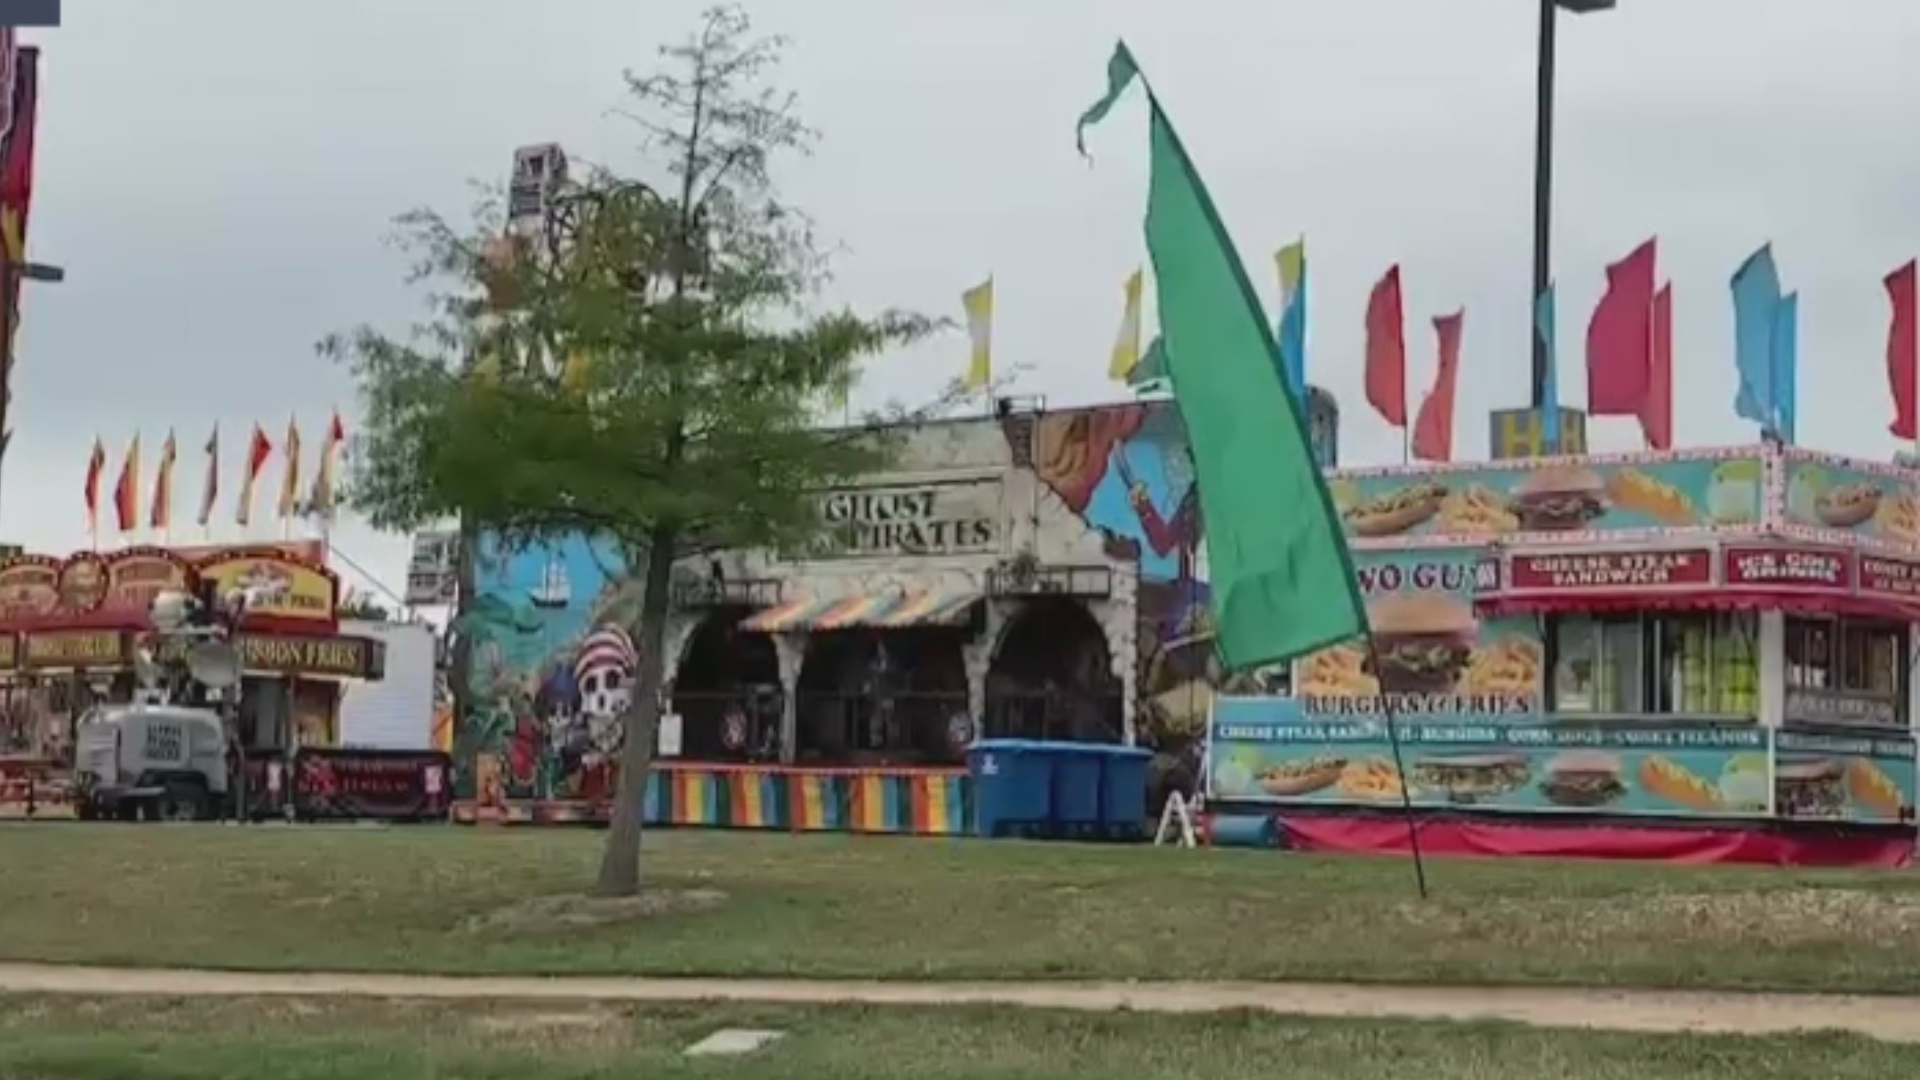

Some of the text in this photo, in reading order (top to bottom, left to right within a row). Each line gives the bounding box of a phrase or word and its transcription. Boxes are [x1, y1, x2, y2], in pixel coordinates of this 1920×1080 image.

[824, 490, 937, 522] GHOST
[849, 518, 992, 553] PIRATES
[1530, 553, 1690, 576] CHEESE STEAK
[1553, 567, 1669, 587] SANDWICH
[306, 641, 358, 667] FRIES
[1305, 694, 1423, 714] BURGERS
[1454, 695, 1530, 714] FRIES
